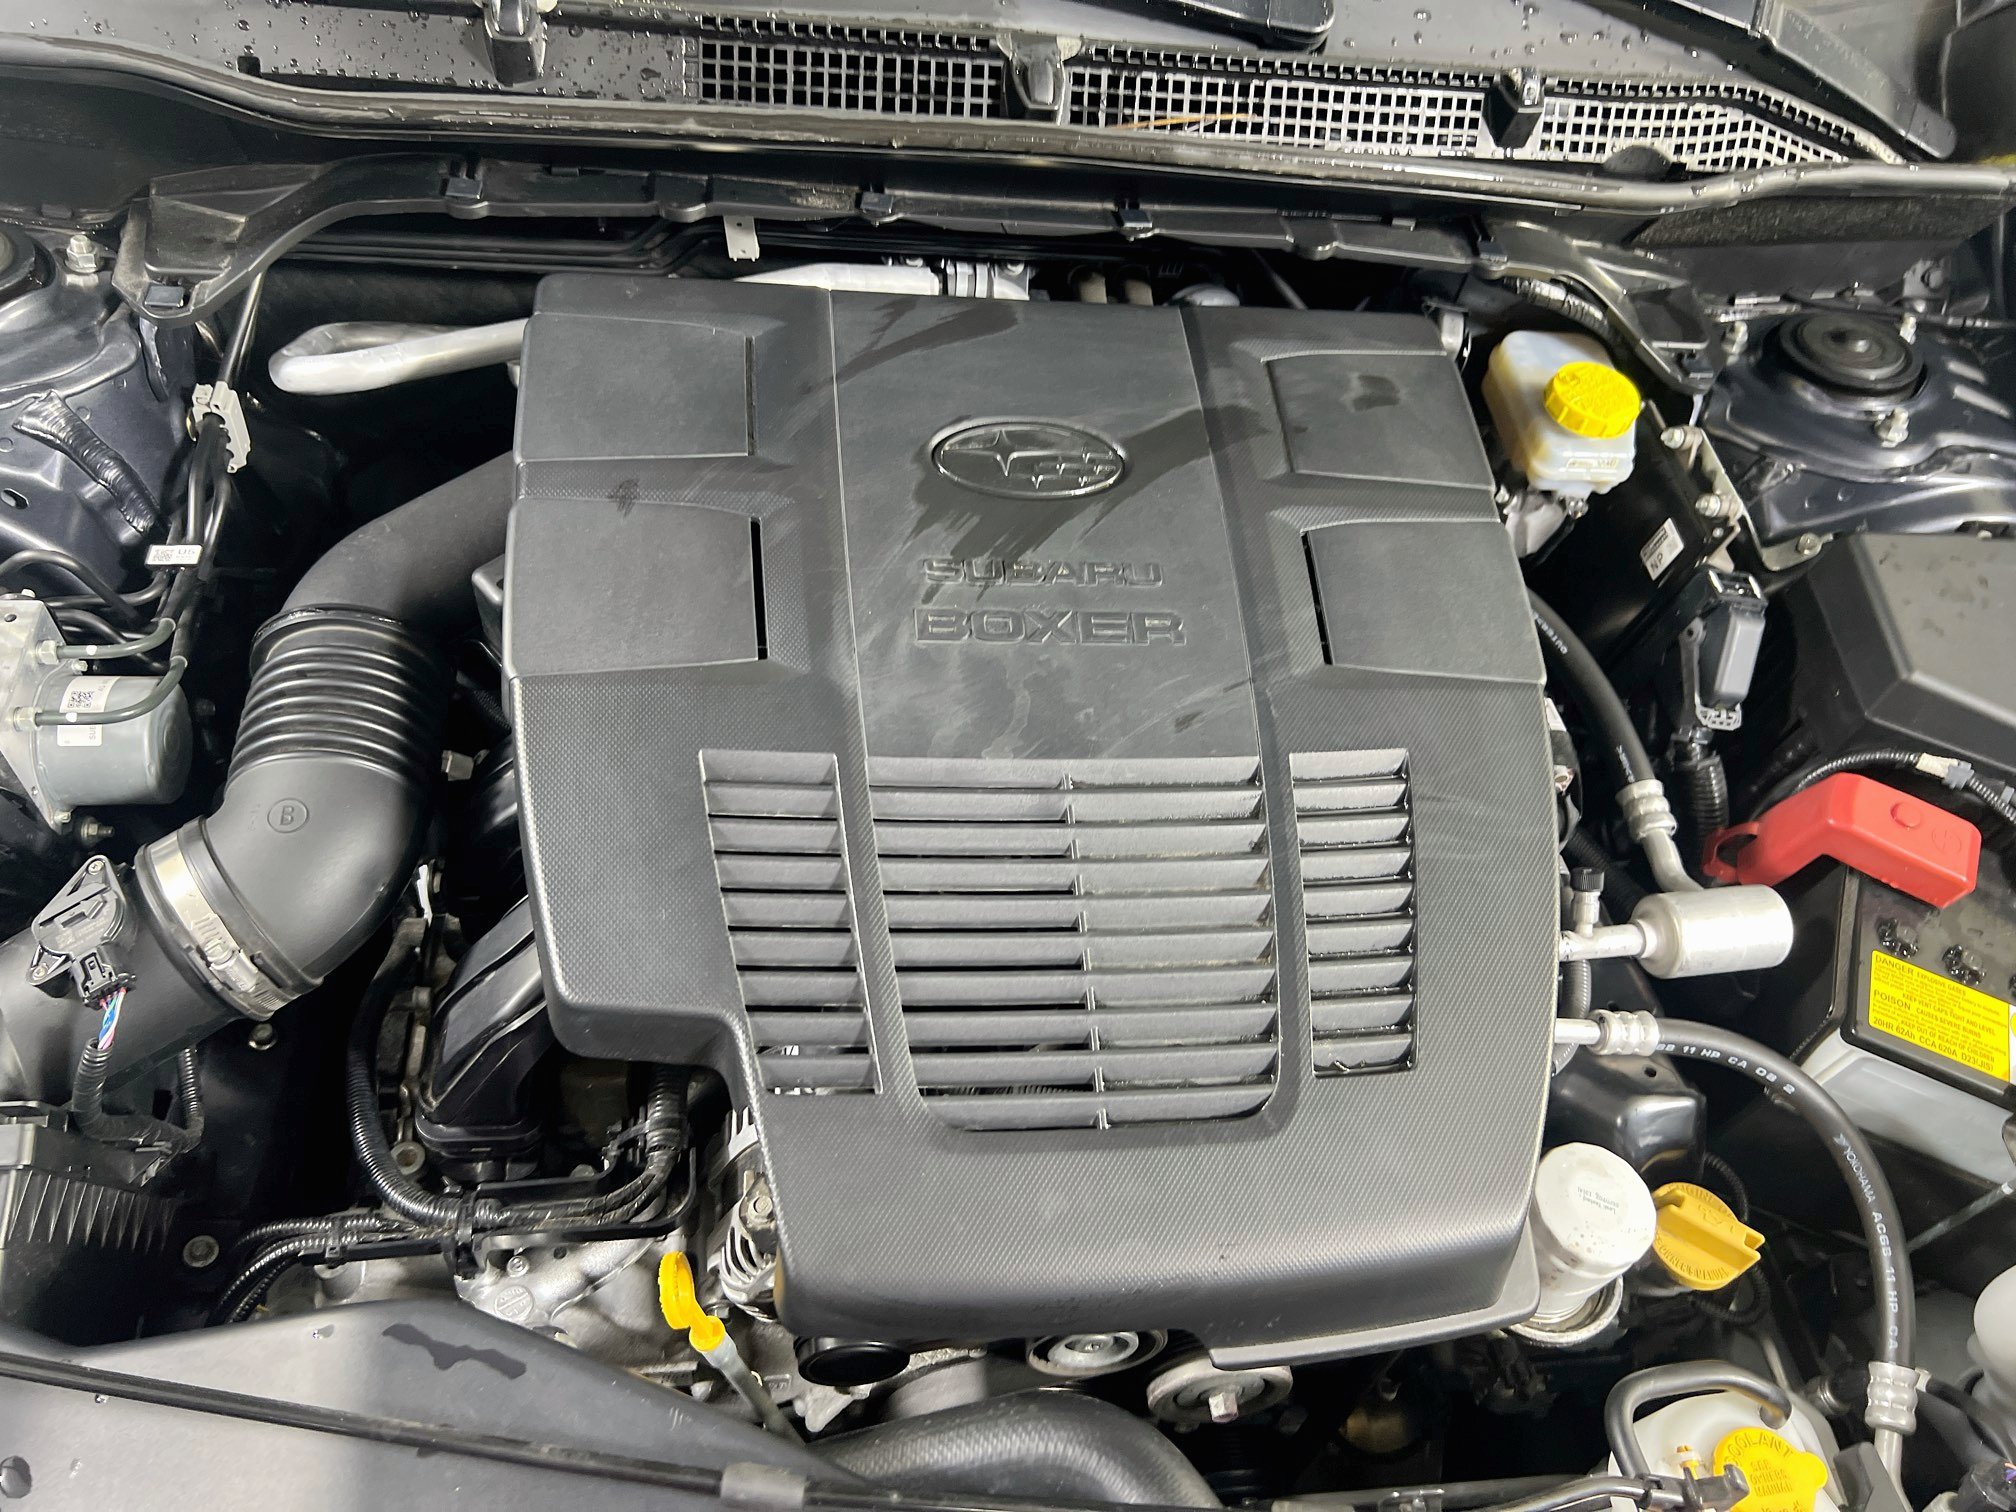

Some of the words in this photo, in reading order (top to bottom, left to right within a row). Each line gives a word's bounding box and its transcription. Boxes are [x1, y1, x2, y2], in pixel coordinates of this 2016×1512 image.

[923, 558, 1164, 588] SUBARU
[913, 608, 1187, 646] BOXER
[1876, 954, 1914, 977] DANGER
[1874, 989, 1911, 1011] POISON
[1874, 1016, 1894, 1031] 20HR
[1896, 1024, 1916, 1040] 62Ah
[1919, 1036, 1937, 1050] CCA
[1938, 1043, 1957, 1058] 620A
[1682, 1045, 1696, 1054] 11
[1700, 1048, 1721, 1059] HP
[1727, 1056, 1748, 1069] CA
[1843, 1144, 1876, 1204] YOKOHAMA
[1884, 1267, 1896, 1283] 11
[1886, 1289, 1899, 1315] HP
[1888, 1325, 1899, 1350] CA
